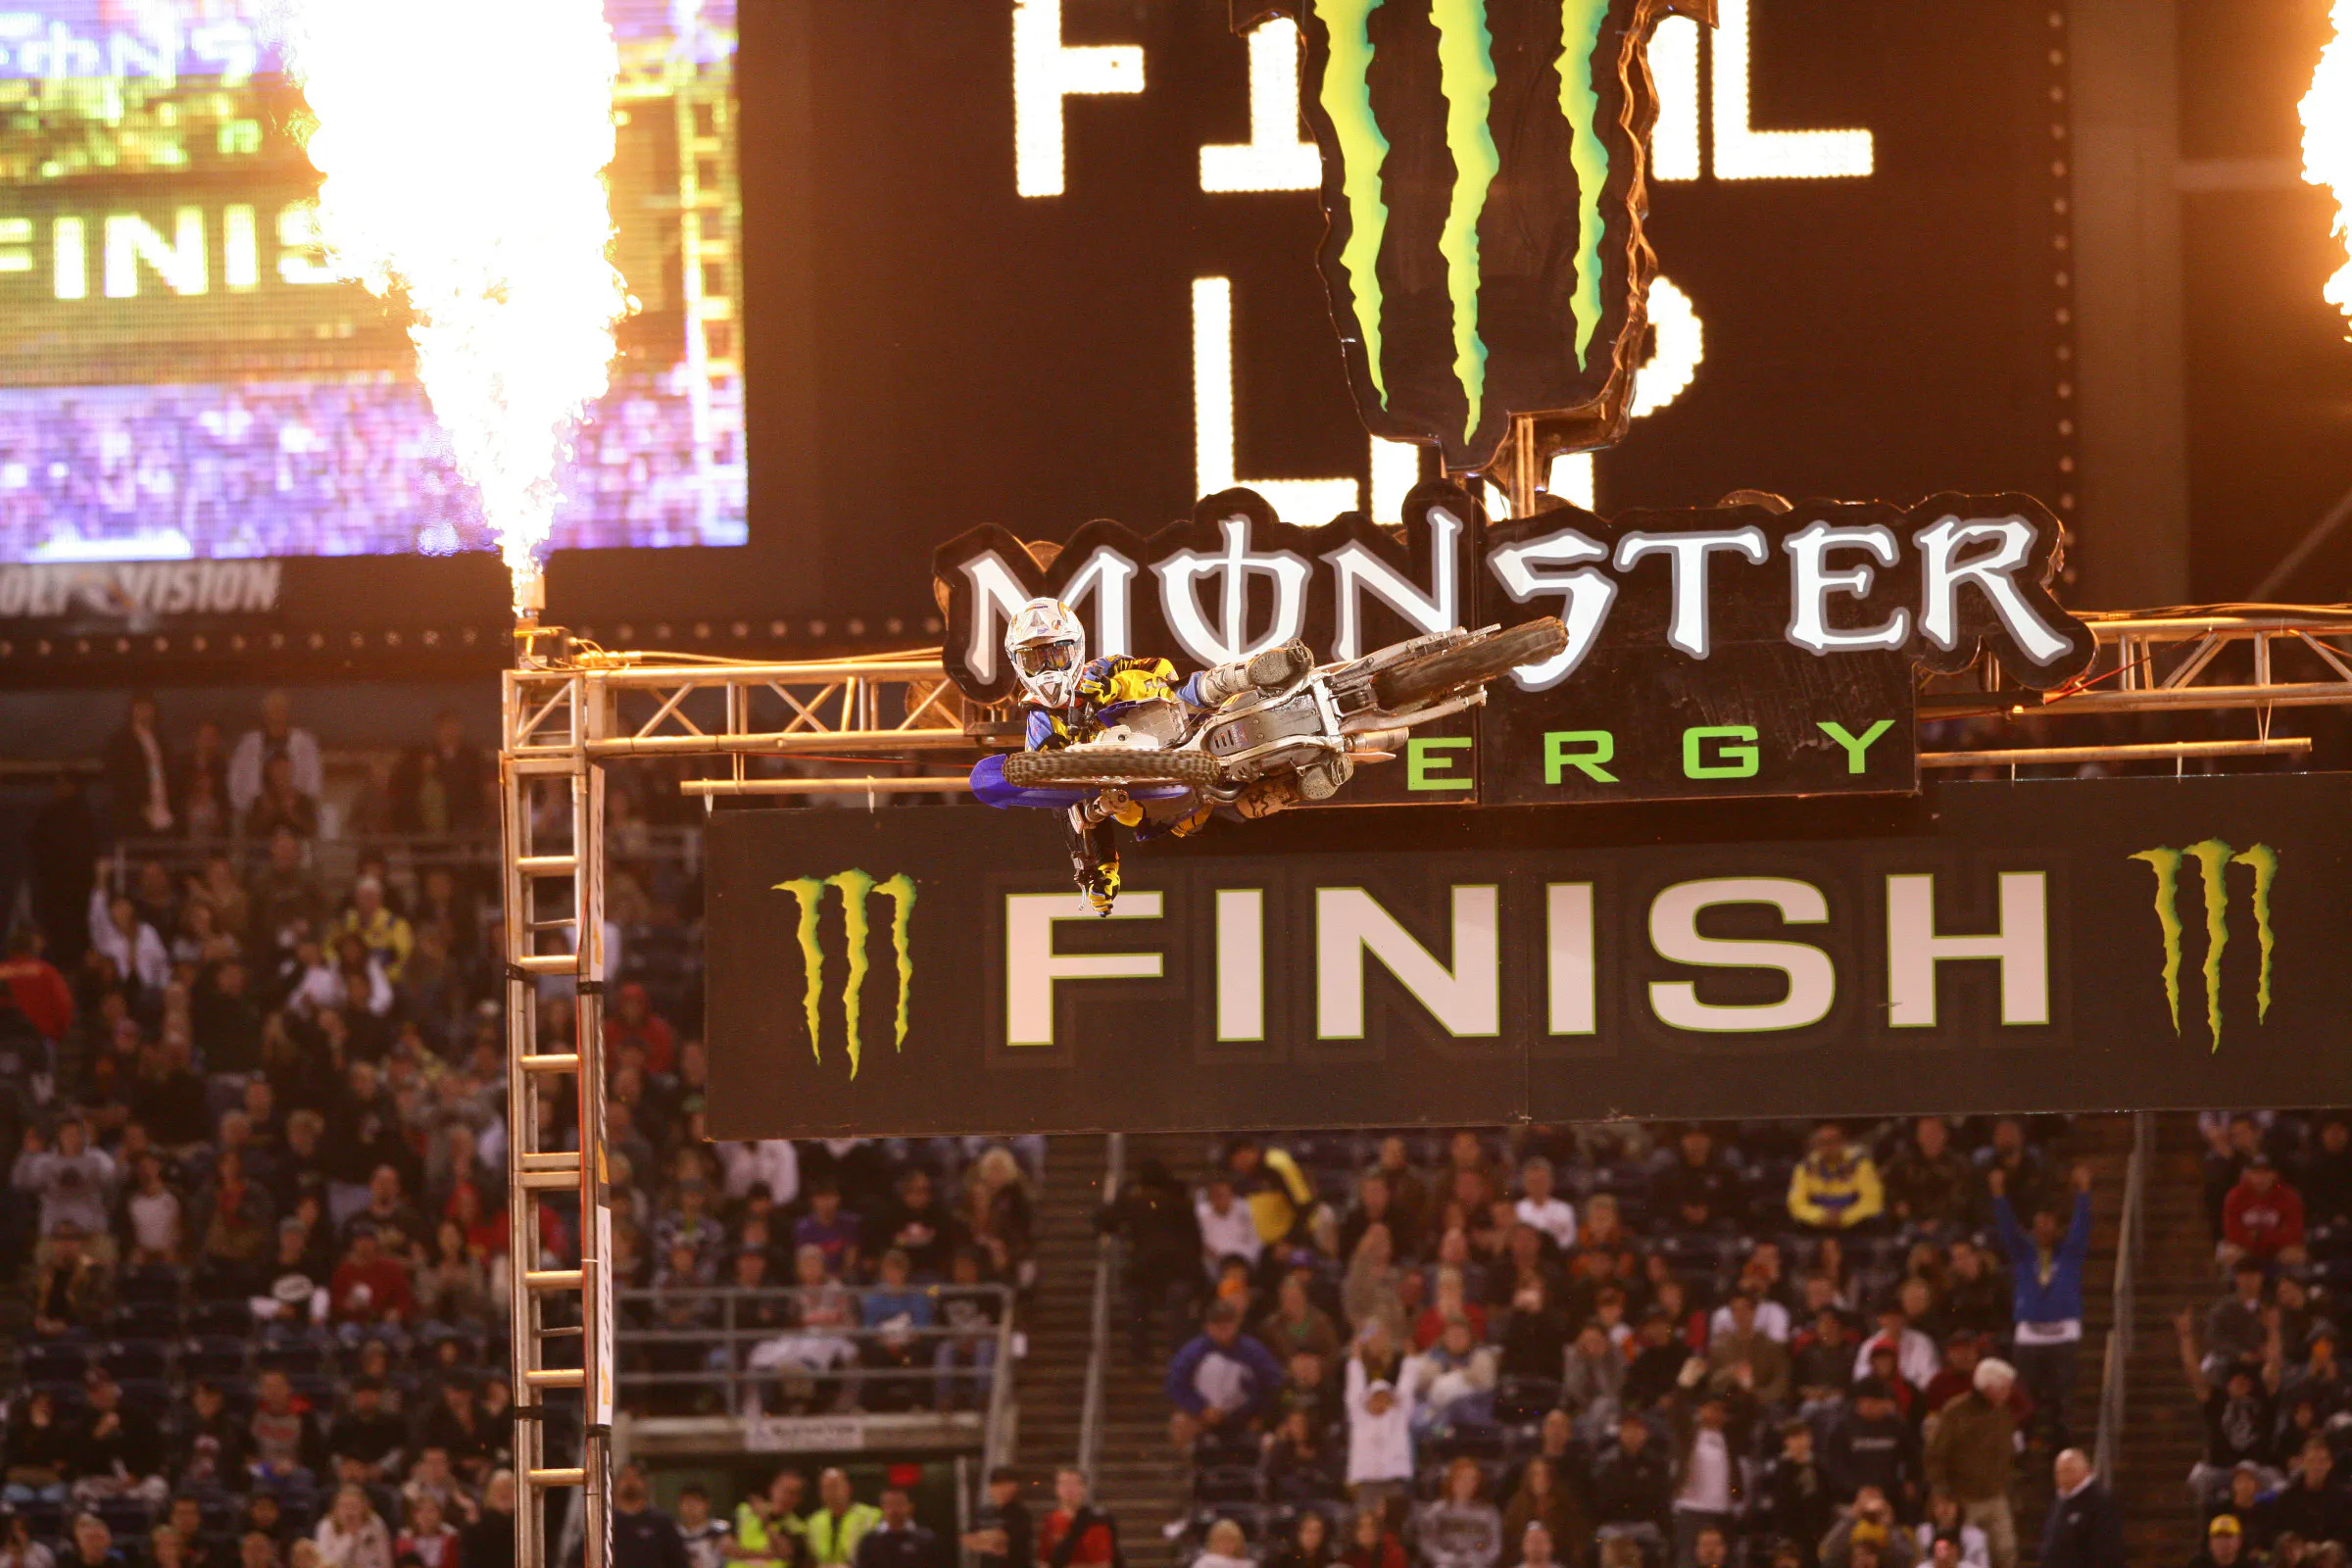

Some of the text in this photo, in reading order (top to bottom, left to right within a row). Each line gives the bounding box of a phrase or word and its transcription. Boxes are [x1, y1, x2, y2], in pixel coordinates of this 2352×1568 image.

[118, 561, 280, 615] VISION
[958, 506, 2073, 691] MONSTER
[1407, 719, 1895, 791] ERGY
[1005, 869, 2050, 1047] FINISH
